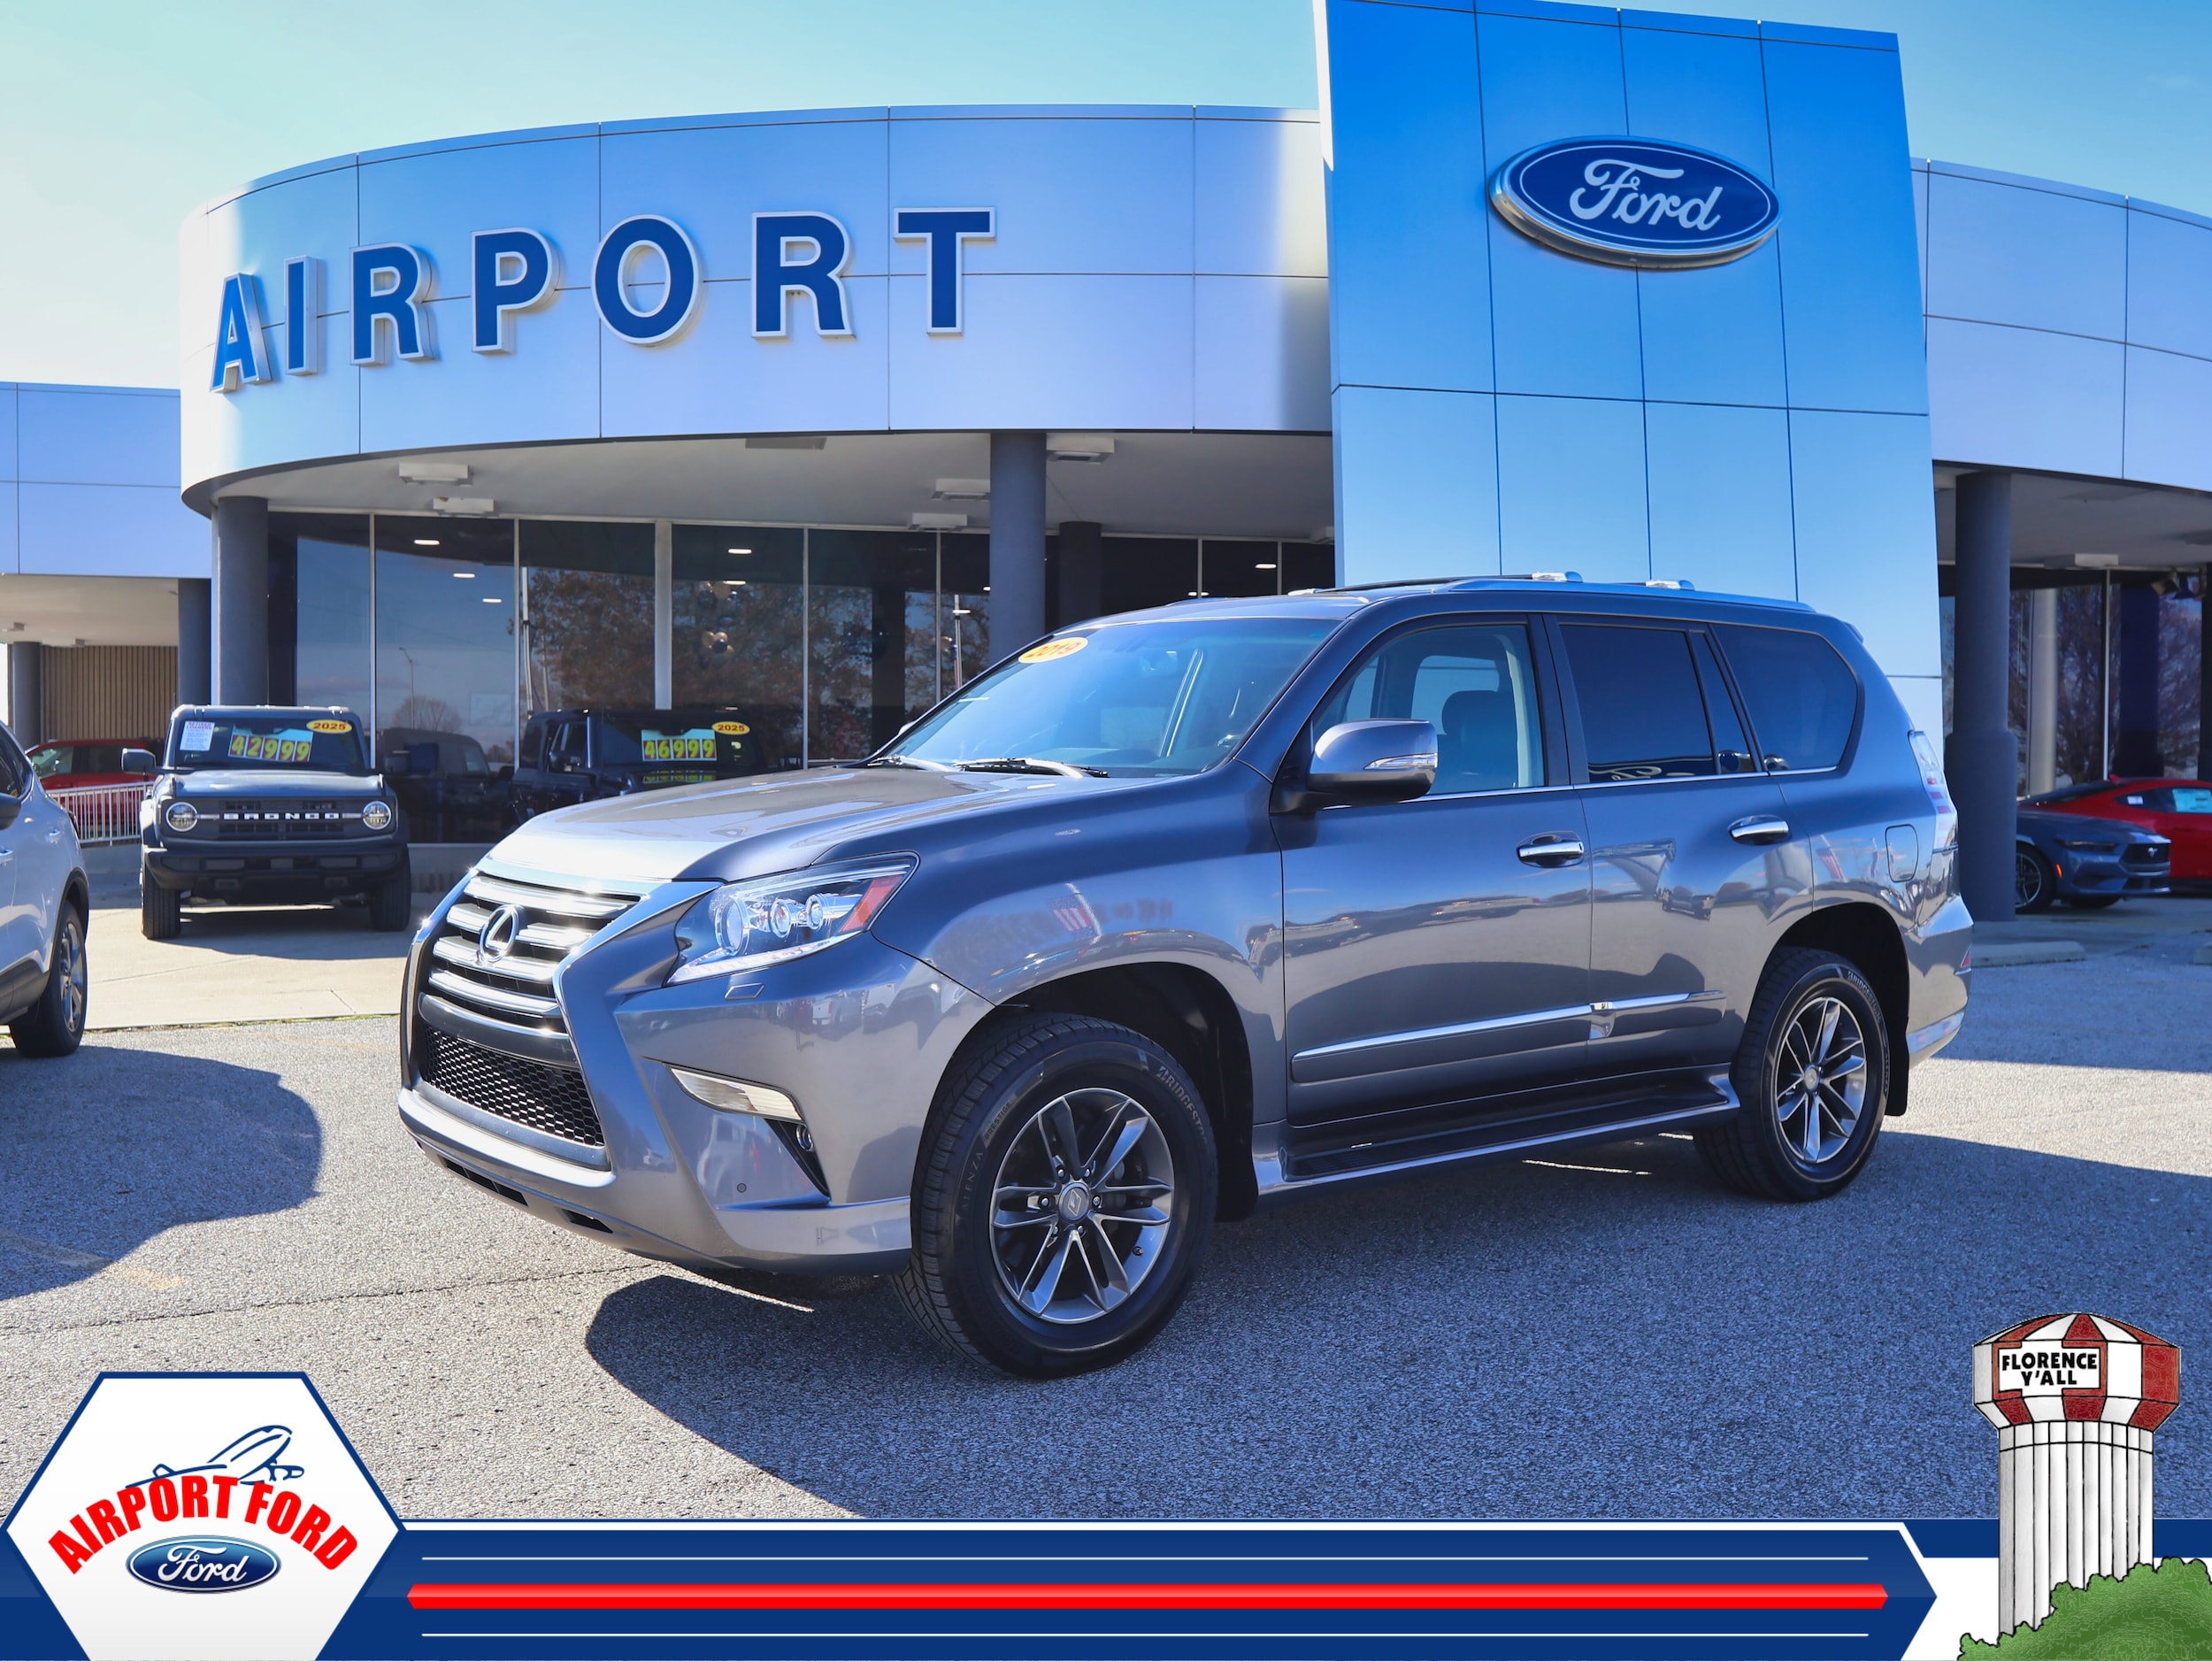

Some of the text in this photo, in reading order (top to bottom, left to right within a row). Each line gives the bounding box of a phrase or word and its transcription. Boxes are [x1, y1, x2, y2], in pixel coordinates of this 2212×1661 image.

[1570, 159, 1723, 231] Ford
[209, 206, 996, 394] AIRPORT
[313, 722, 346, 731] 2025
[232, 735, 310, 760] 42999
[644, 740, 714, 758] 46999
[984, 1101, 1012, 1140] PRESTIGE
